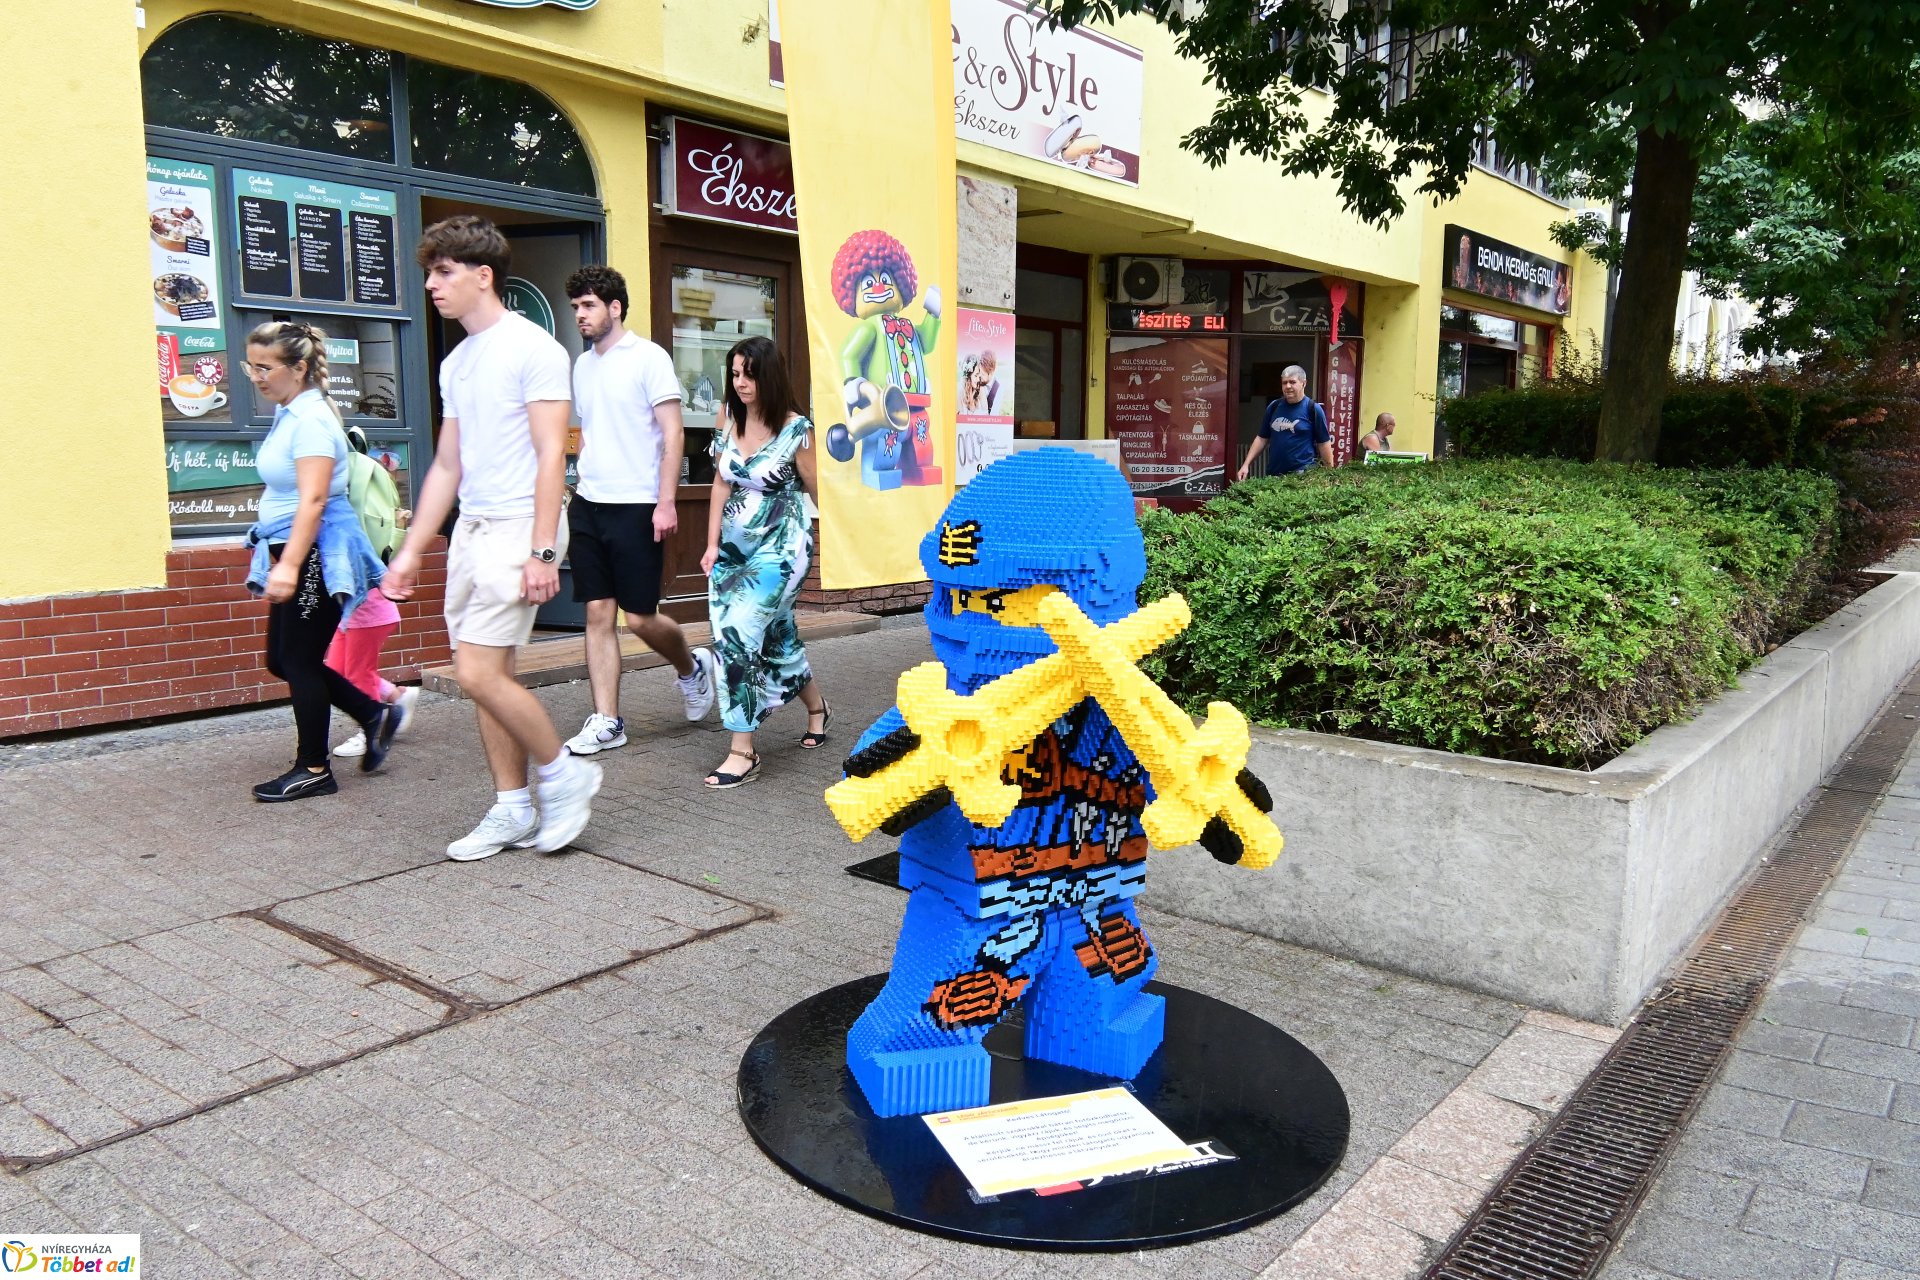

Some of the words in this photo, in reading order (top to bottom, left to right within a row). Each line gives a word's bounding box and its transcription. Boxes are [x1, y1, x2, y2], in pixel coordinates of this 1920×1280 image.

[965, 47, 987, 90] &
[990, 14, 1099, 116] Style
[172, 167, 209, 181] ajánlata
[688, 143, 798, 219] Éksze
[1477, 246, 1504, 274] BENDA
[1505, 255, 1530, 281] KEBAB
[1530, 263, 1537, 283] és
[1537, 266, 1554, 288] GRILL
[325, 344, 354, 358] Nyitva
[197, 356, 218, 366] COSTA
[1121, 358, 1167, 366] KULCSMÁSOLÁS
[196, 373, 221, 384] COFFEE
[1181, 374, 1217, 382] CIPŐJAVÍTÁS
[328, 389, 360, 397] zombatig
[1184, 402, 1195, 410] KÉS
[1188, 410, 1210, 418] ÉLEZÉS
[1118, 431, 1154, 439] PATENTOZÁS
[1178, 433, 1218, 441] TÁSKAJAVÍTÁS
[215, 452, 229, 472] új
[232, 450, 258, 467] hűs
[168, 499, 214, 515] Kóstold
[215, 504, 236, 518] meg
[238, 504, 246, 512] a
[247, 498, 260, 512] hé
